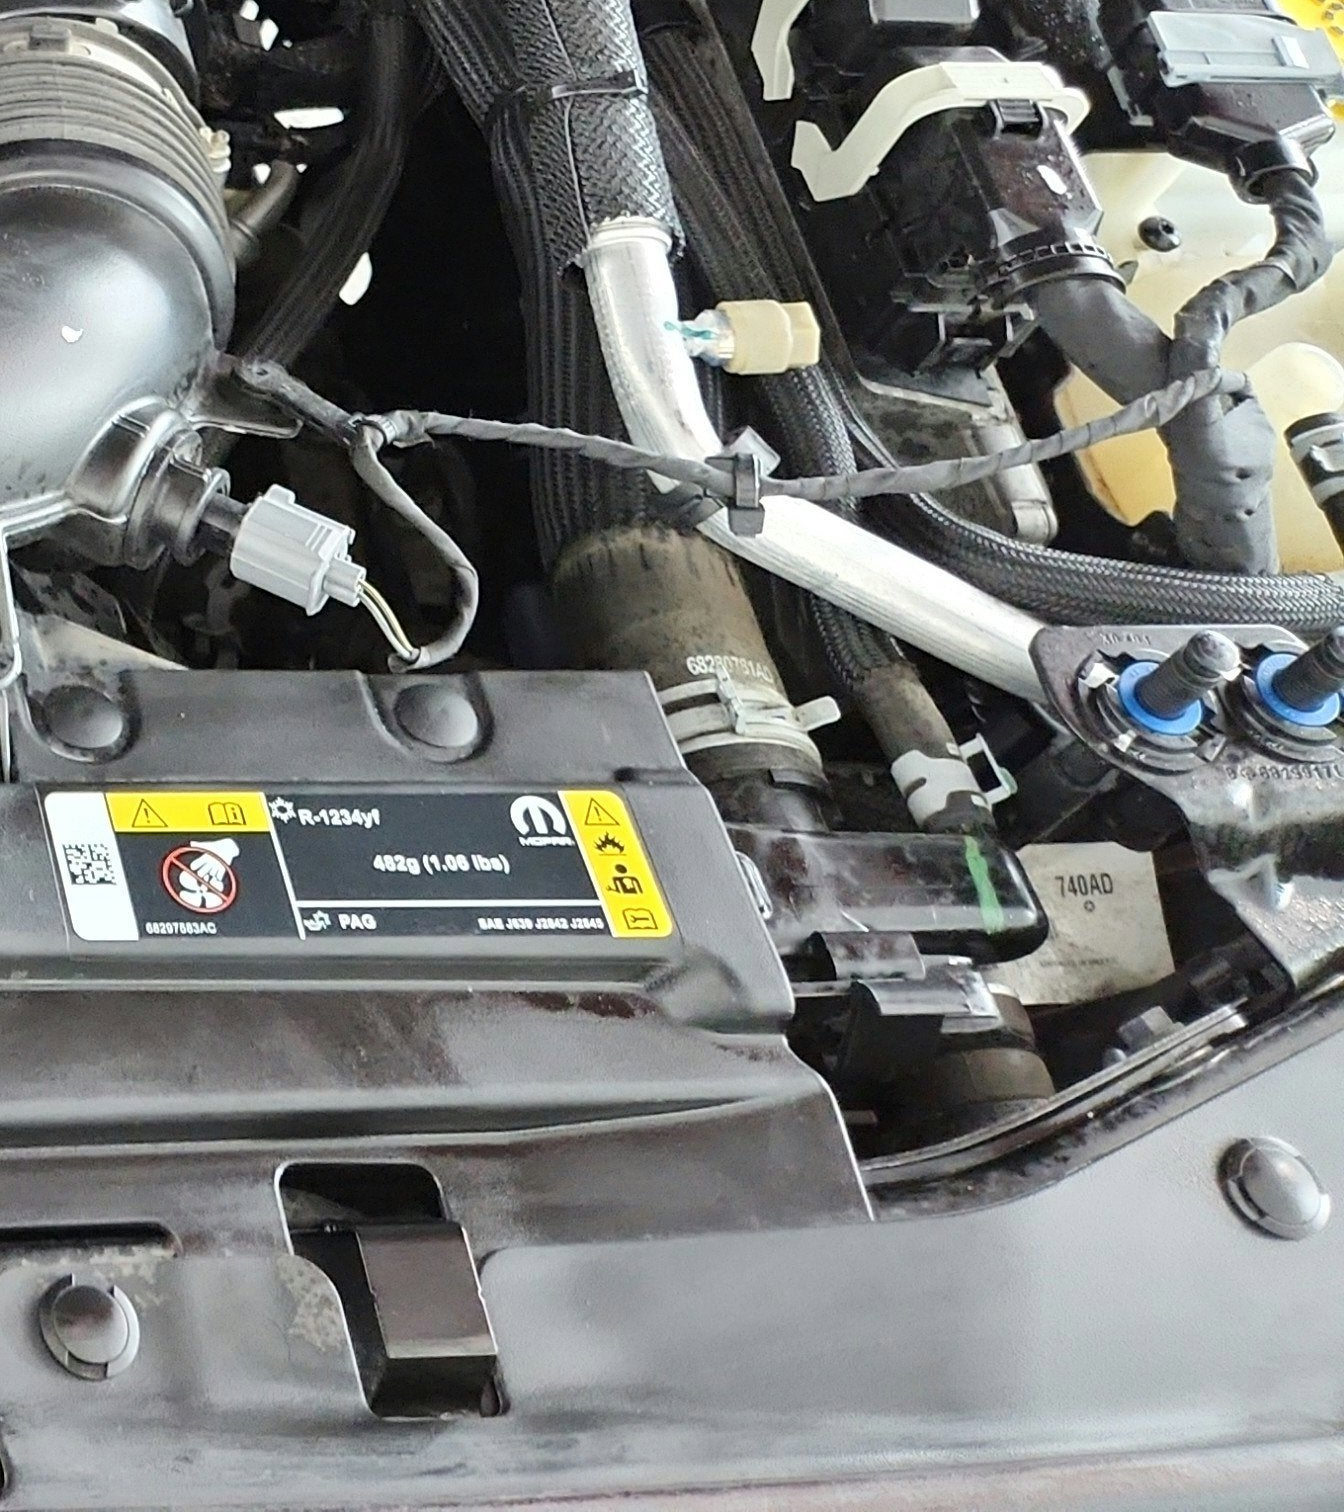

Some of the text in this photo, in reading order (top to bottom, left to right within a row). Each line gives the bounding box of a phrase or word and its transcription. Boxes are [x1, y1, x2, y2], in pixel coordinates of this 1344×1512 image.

[298, 808, 380, 829] R-1234yf
[1055, 873, 1113, 897] 740AD
[338, 913, 376, 930] PAG
